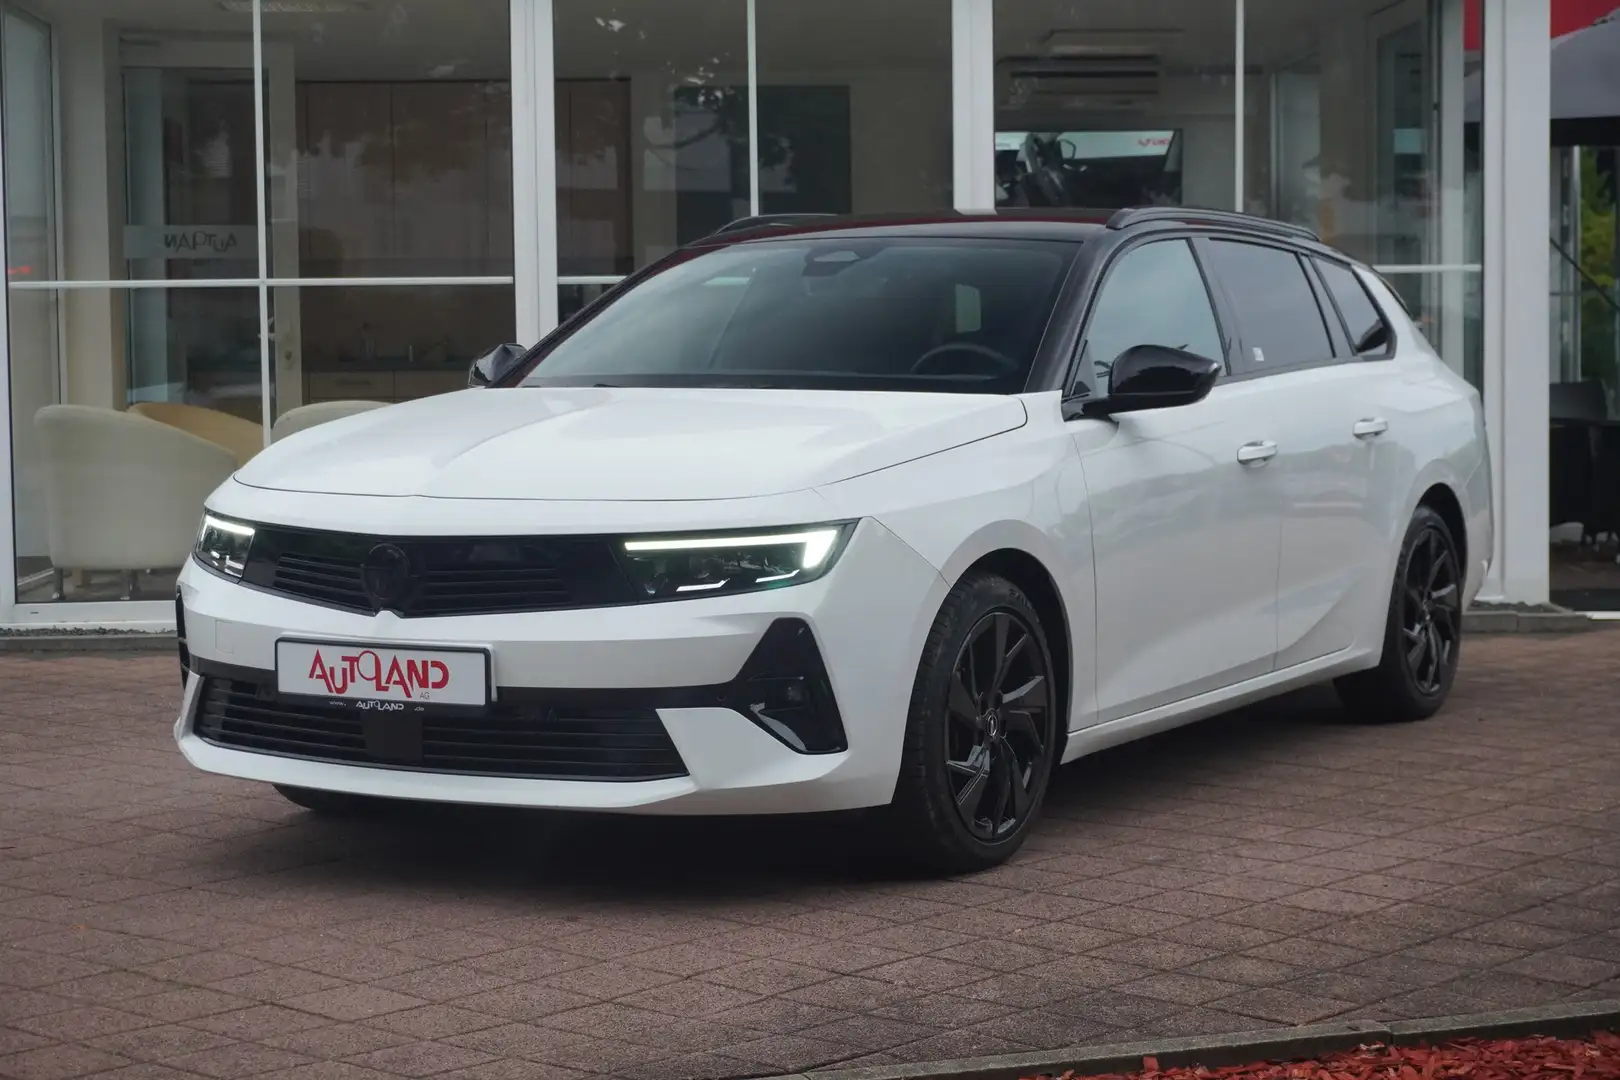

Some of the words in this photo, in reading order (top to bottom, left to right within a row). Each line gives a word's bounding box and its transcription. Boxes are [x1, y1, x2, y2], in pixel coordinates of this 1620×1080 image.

[309, 649, 449, 698] AUTOLAND
[420, 692, 430, 700] AG
[356, 700, 404, 711] AUTOLAND
